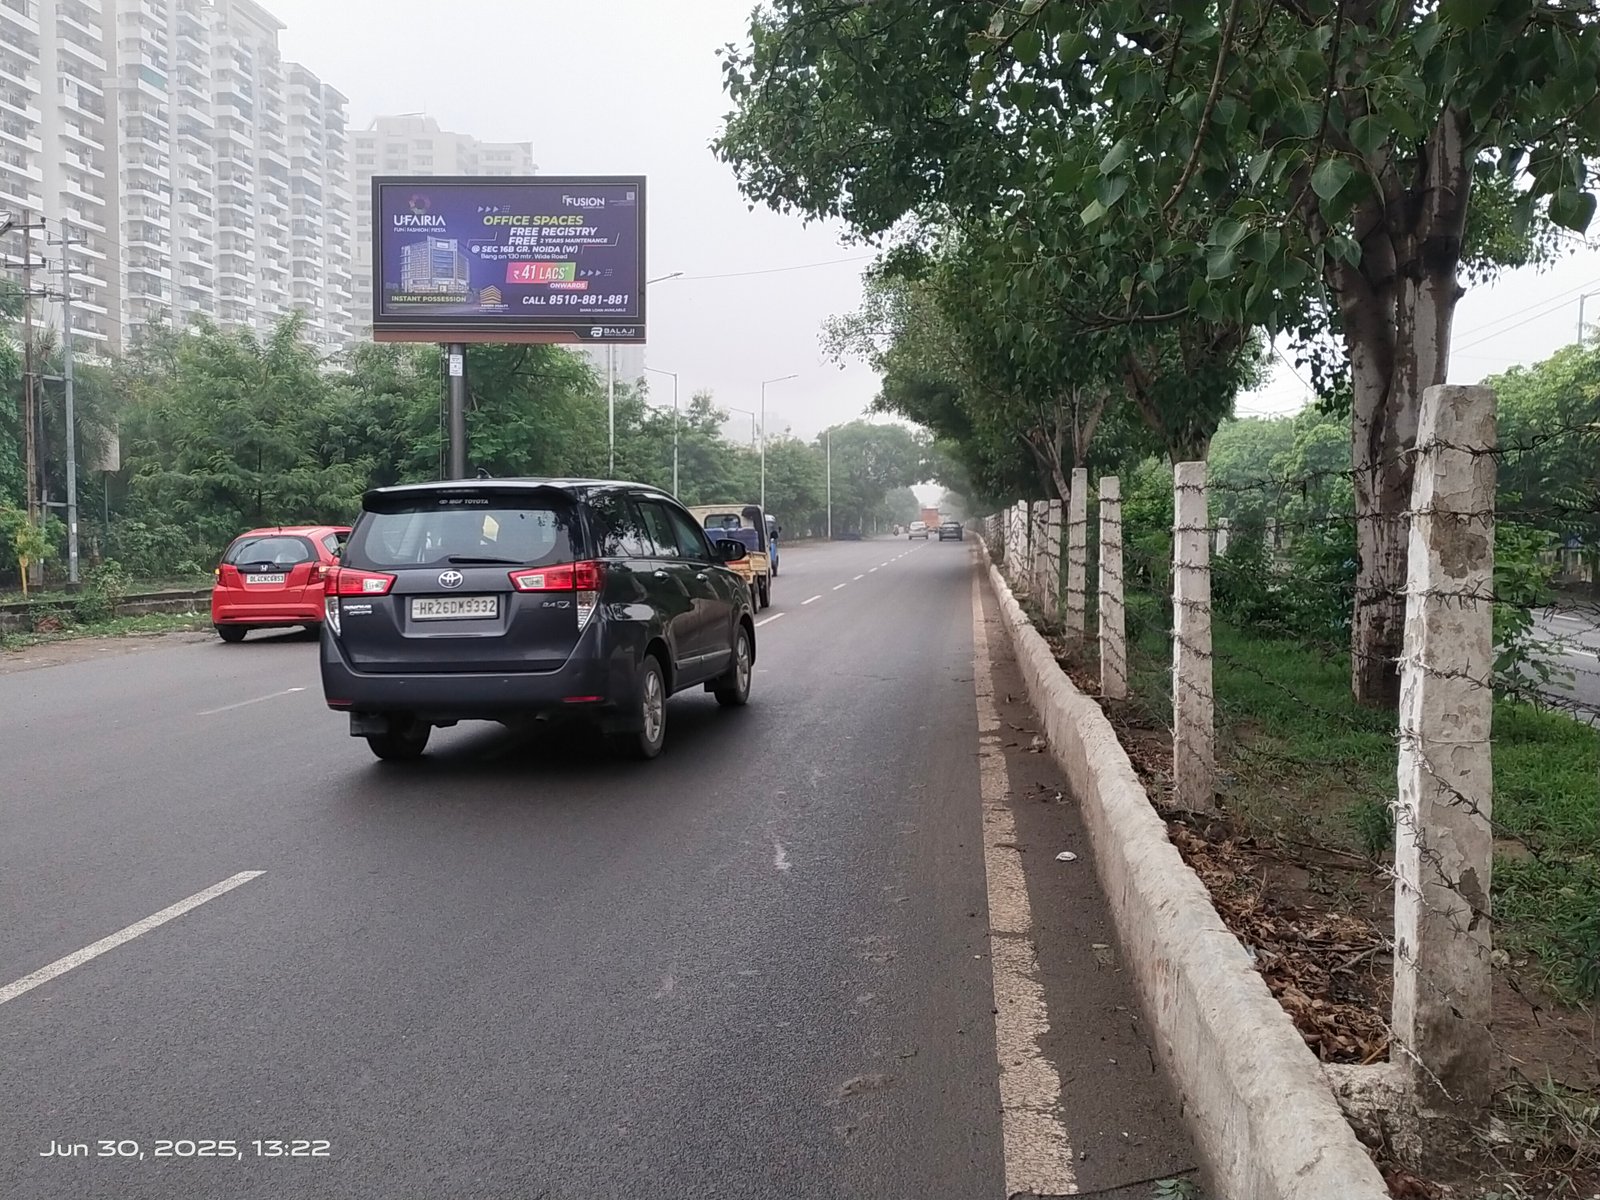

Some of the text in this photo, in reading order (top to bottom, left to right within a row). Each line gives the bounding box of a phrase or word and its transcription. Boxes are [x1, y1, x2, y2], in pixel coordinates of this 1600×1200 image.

[484, 215, 584, 226] OFFICE SPACES
[510, 227, 598, 236] FREE REGISTRY
[508, 236, 538, 246] FREE
[472, 244, 480, 254] @
[562, 245, 578, 254] (W)
[549, 294, 628, 304] 8510-881-881
[420, 600, 496, 615] HR26DM9332
